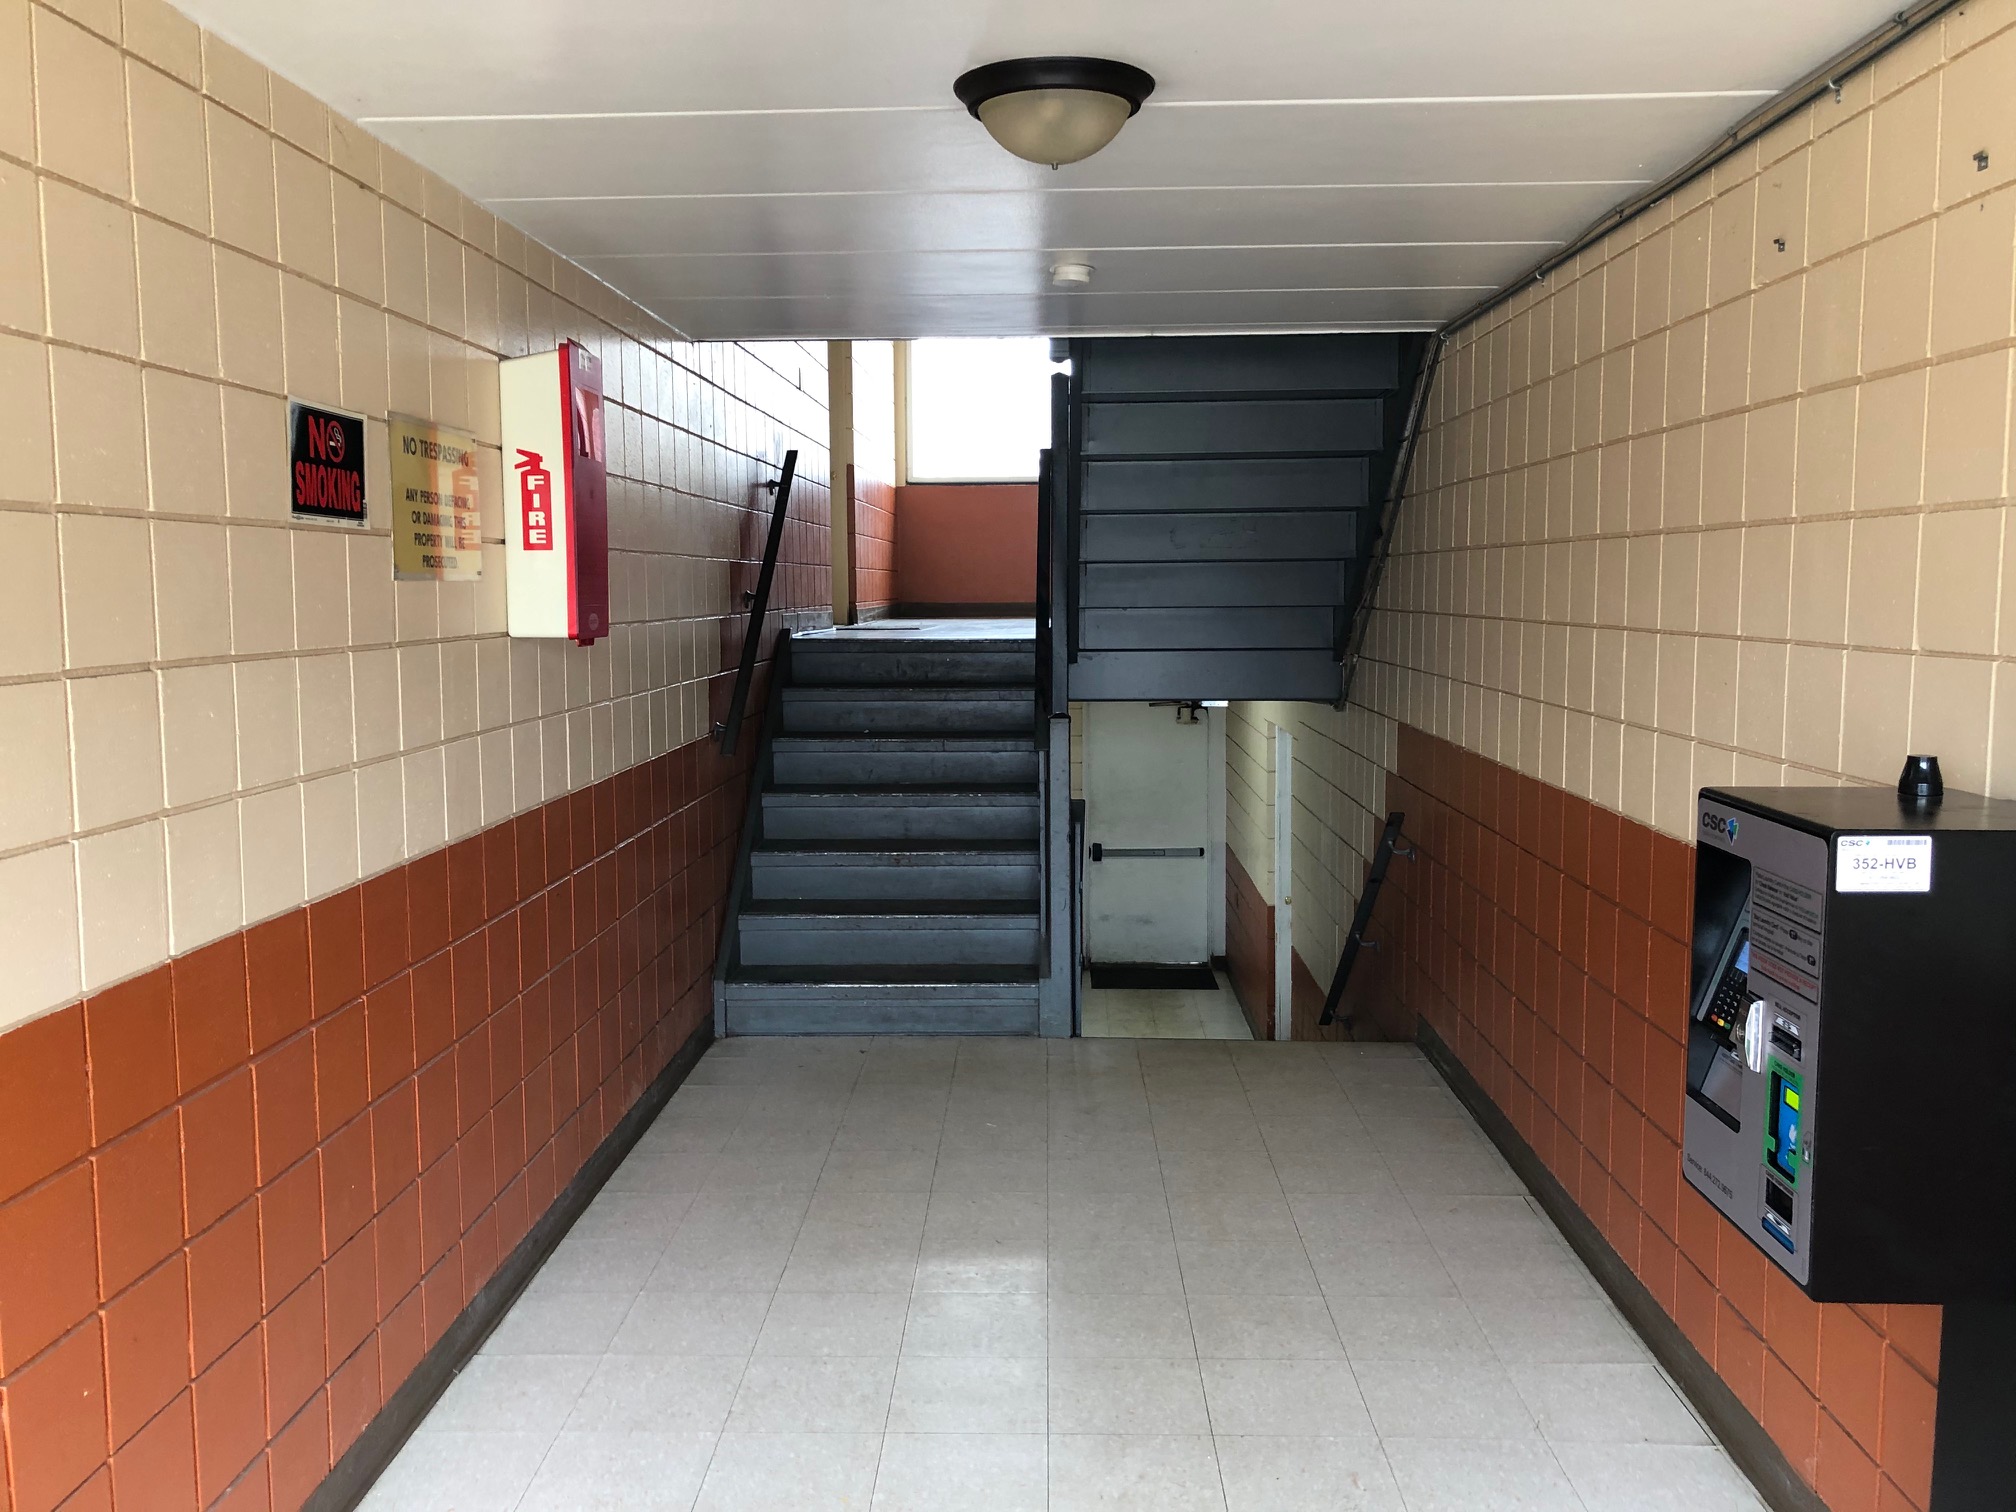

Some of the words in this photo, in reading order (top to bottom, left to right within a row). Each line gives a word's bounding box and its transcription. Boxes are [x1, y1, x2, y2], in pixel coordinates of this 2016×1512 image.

[308, 415, 345, 463] NO
[403, 436, 417, 455] NO
[419, 439, 469, 467] TRESPASSING
[296, 461, 361, 512] SMOKING
[406, 488, 418, 502] ANY
[420, 490, 443, 506] PERSON
[411, 510, 421, 524] OR
[527, 475, 546, 544] FIRE
[414, 533, 443, 548] PROPERTY
[1702, 812, 1726, 833] CSC
[1853, 857, 1917, 870] 352-HVB
